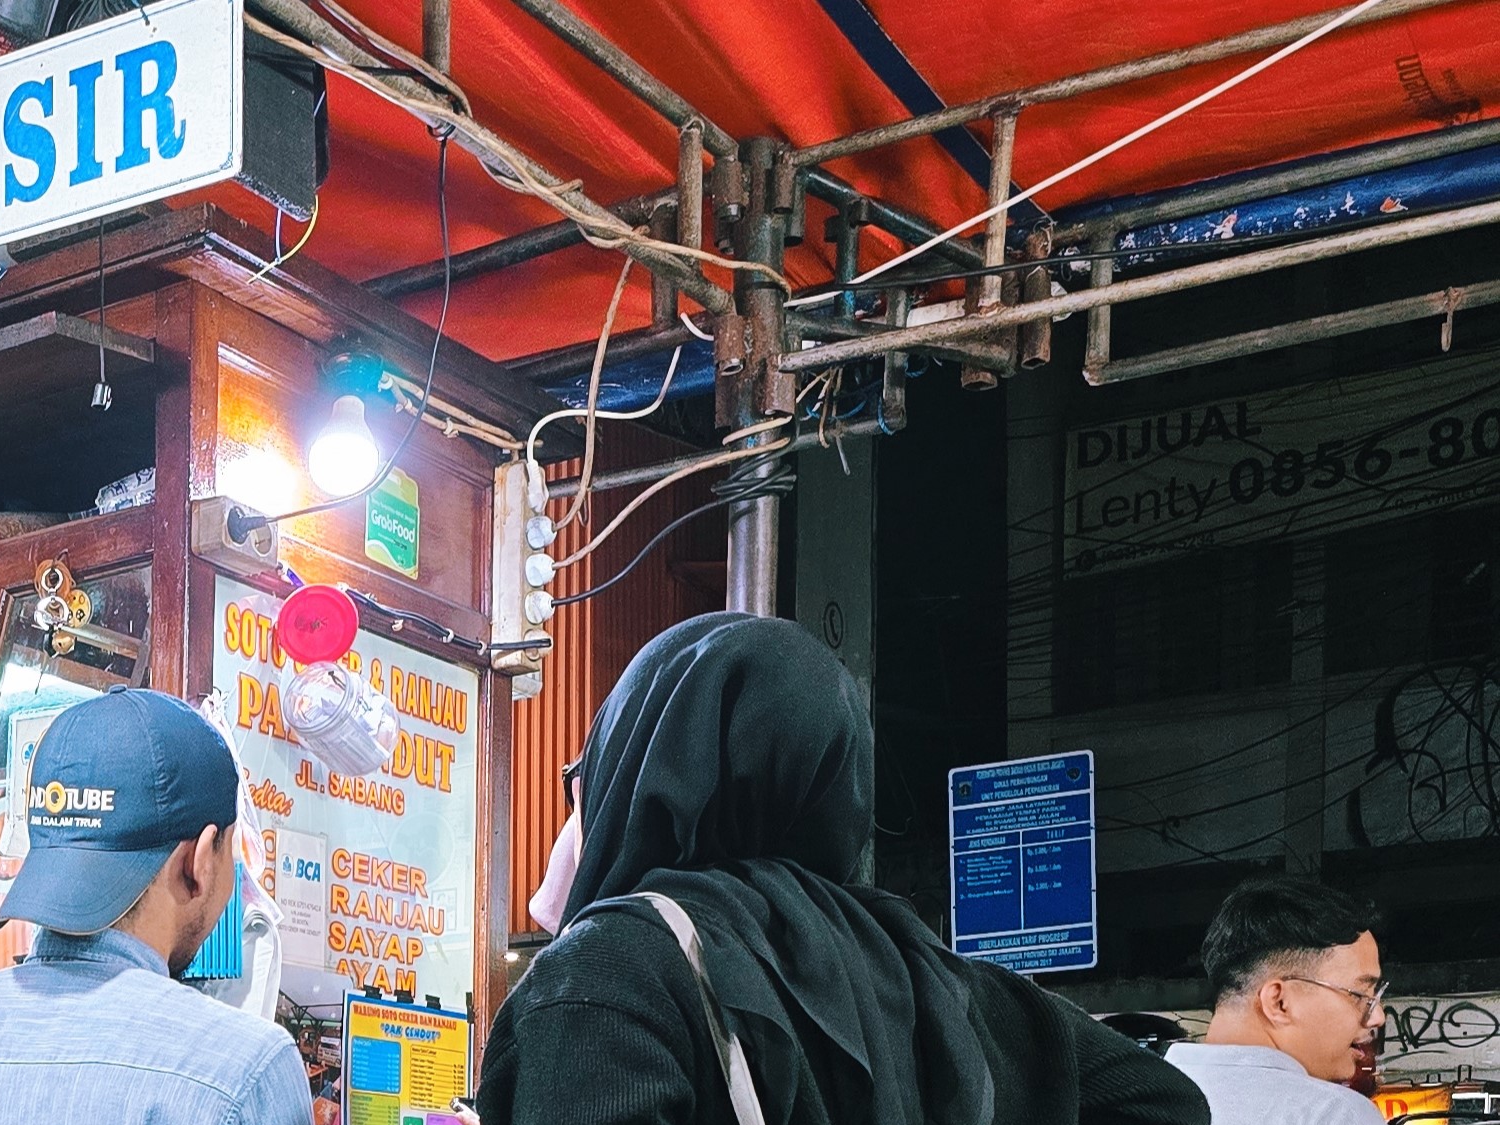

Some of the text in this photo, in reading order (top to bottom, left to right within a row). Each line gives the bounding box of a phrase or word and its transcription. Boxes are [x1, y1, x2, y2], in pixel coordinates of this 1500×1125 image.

[1077, 400, 1261, 469] DIJUAL
[371, 509, 416, 544] GrabFood
[1076, 478, 1217, 534] Lenty
[238, 671, 300, 747] PA
[391, 665, 468, 734] RANJAU
[243, 767, 294, 818] edia:
[329, 772, 406, 816] SABANG
[42, 816, 73, 827] DALAM
[74, 817, 102, 828] TRUK
[295, 858, 321, 883] BCA
[332, 848, 428, 899] CEKER
[330, 884, 445, 937] RANJAU
[328, 920, 424, 966] SAYAP
[336, 958, 417, 999] AYAM
[353, 1004, 381, 1019] WARUNG
[381, 1008, 397, 1021] SOTO
[398, 1011, 418, 1025] CEKER
